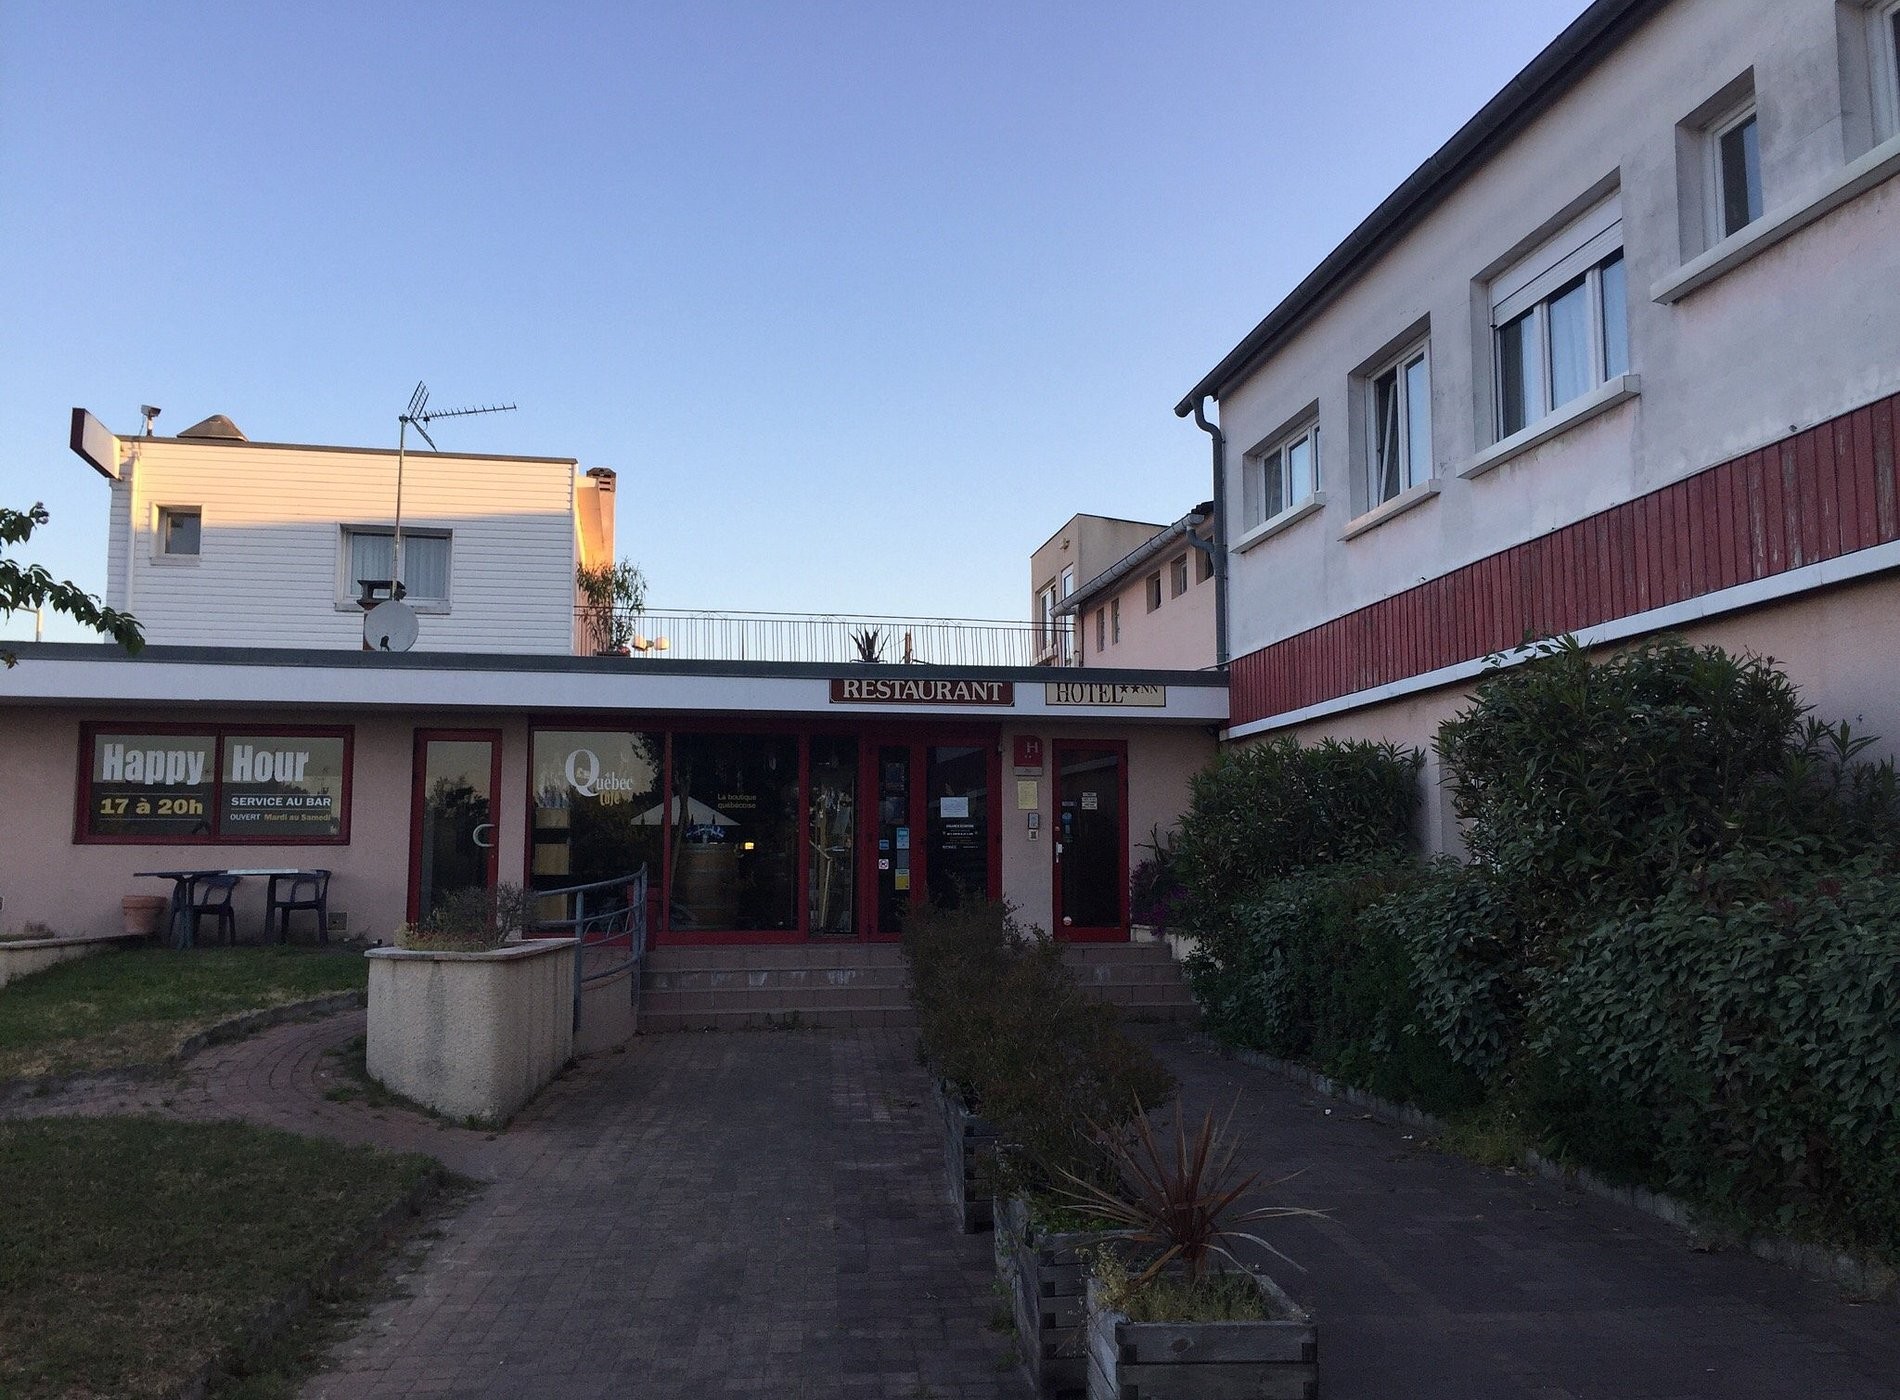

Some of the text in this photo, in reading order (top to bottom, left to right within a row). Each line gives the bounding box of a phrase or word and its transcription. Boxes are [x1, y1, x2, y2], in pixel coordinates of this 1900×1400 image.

[842, 679, 1003, 701] RESTAURANT
[102, 743, 310, 786] Happy Hour
[100, 798, 203, 815] 17 à 20h
[231, 797, 331, 806] SERVICE AU BAR
[230, 813, 261, 821] OUVERT
[264, 813, 288, 821] Mardi
[301, 813, 331, 821] Samedi
